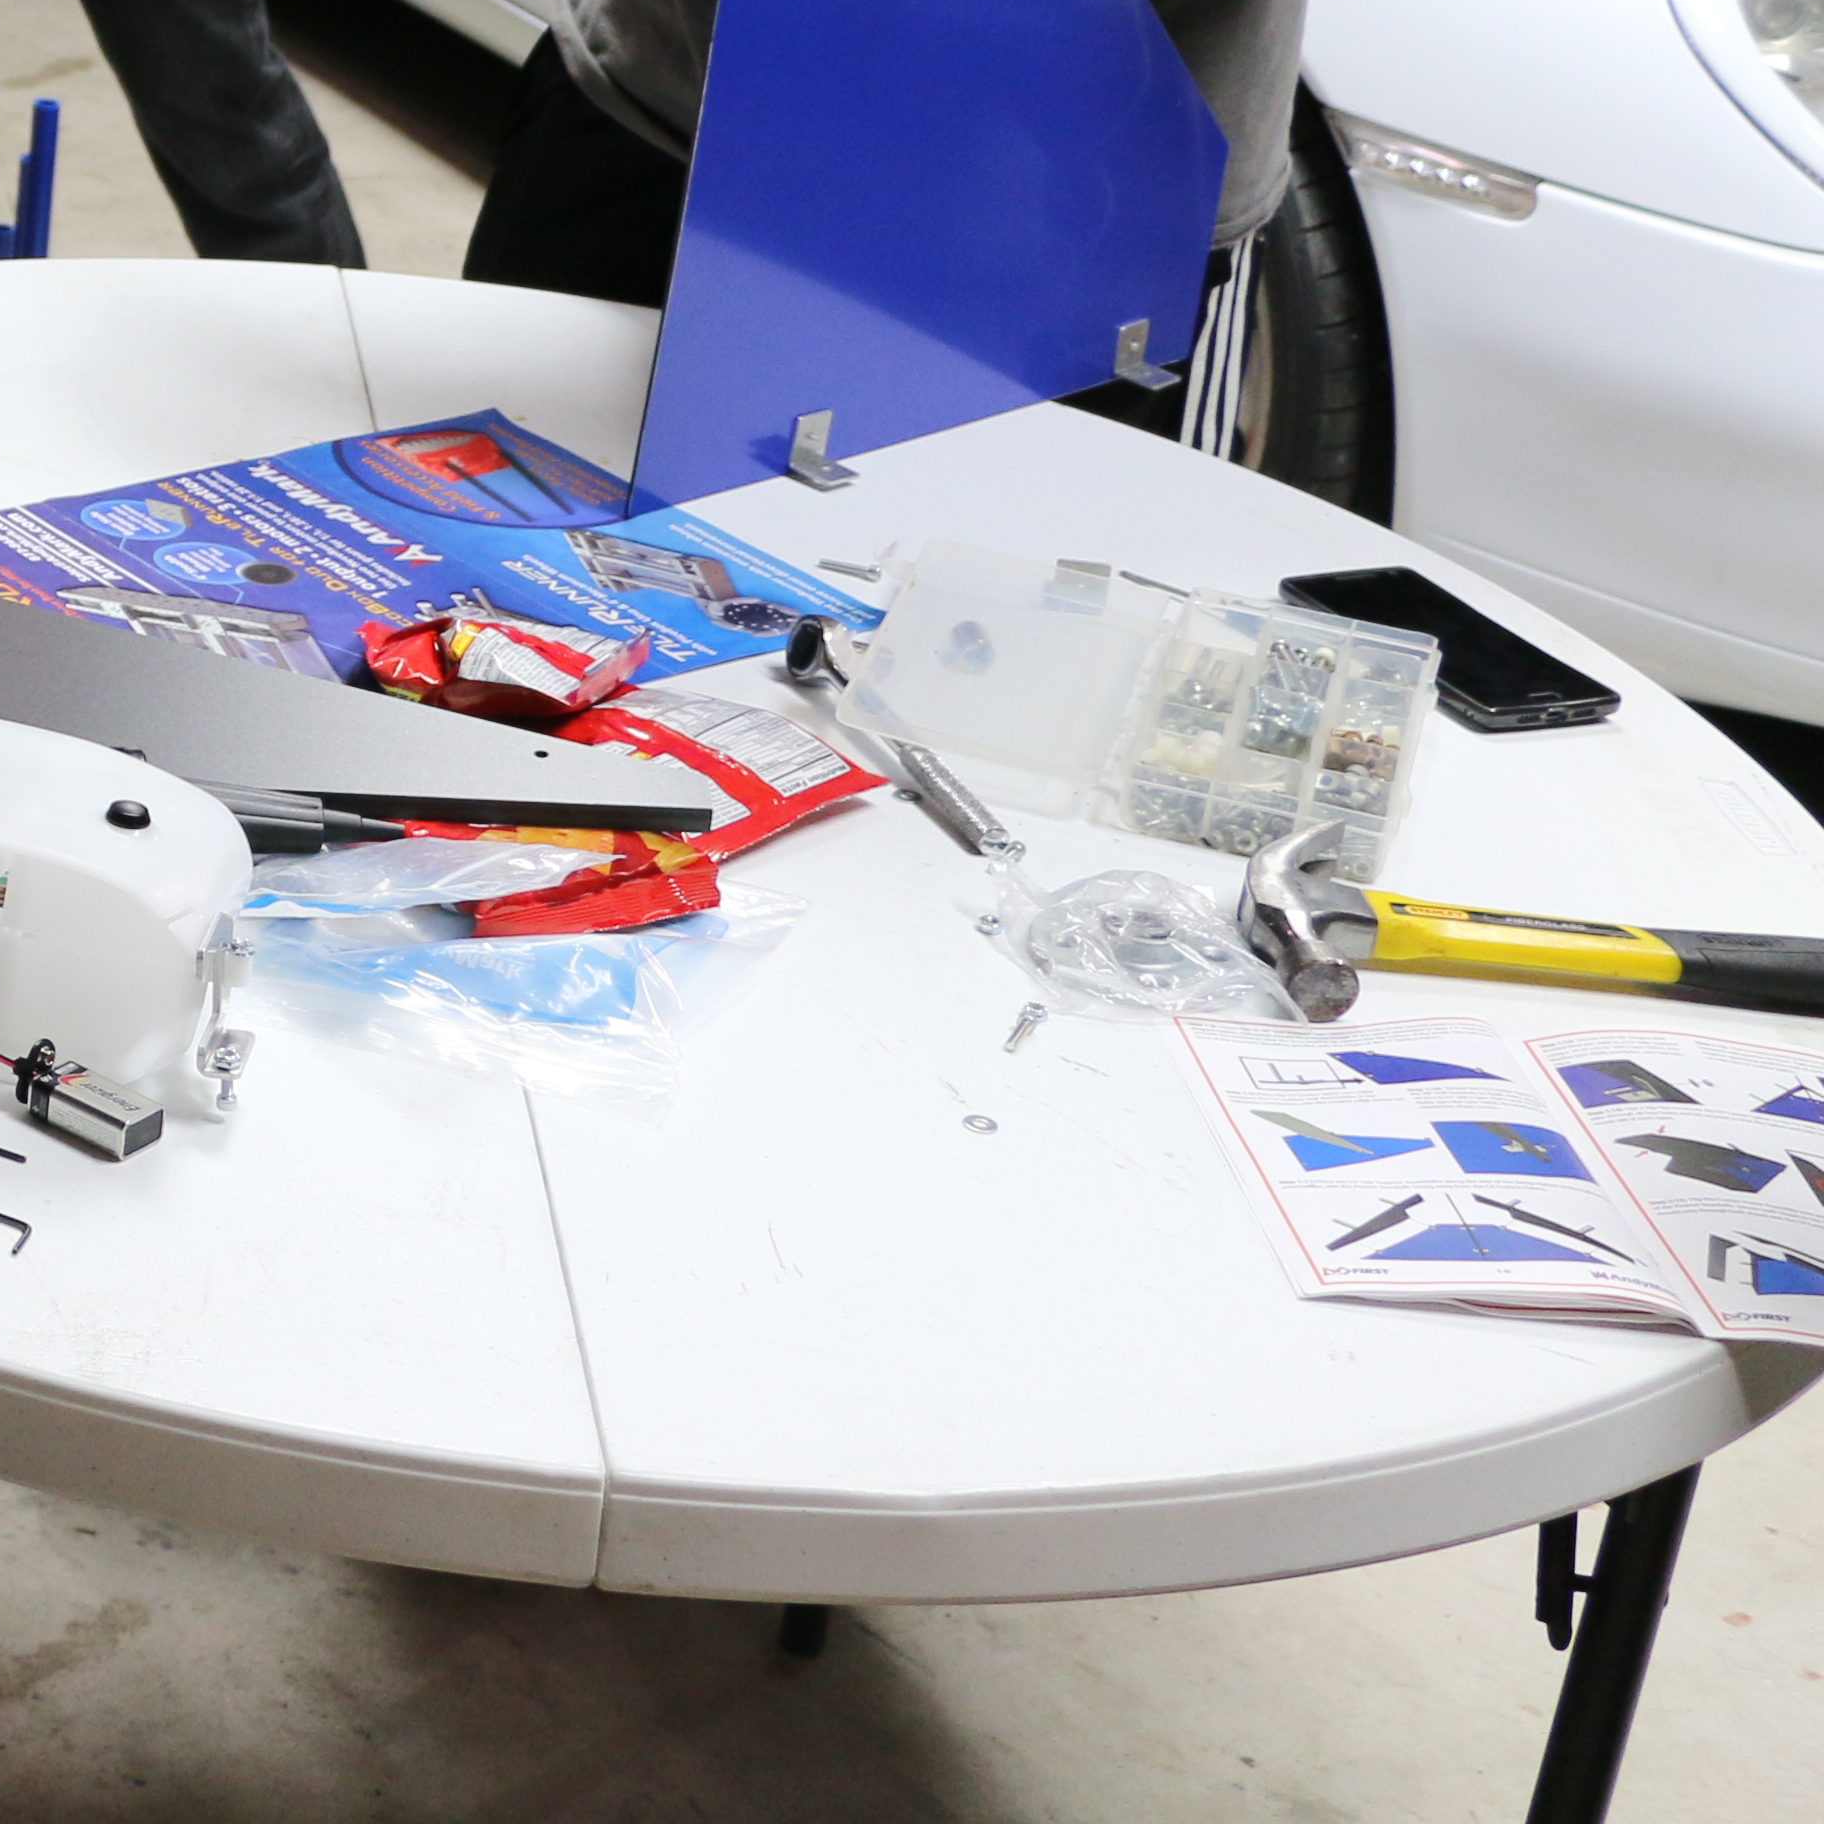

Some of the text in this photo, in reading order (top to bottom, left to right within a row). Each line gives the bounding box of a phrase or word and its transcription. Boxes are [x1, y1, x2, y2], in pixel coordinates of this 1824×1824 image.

[176, 476, 227, 504] ratios
[216, 502, 237, 513] 3
[248, 463, 406, 546] AndyMark
[240, 513, 301, 548] motors
[7, 512, 124, 580] AndyMark.com
[293, 544, 314, 556] 2
[315, 555, 377, 591] output
[1409, 906, 1464, 919] STANLEY
[80, 1081, 142, 1113] Energizer
[1351, 1267, 1390, 1275] FIRST
[1751, 1312, 1791, 1323] FIRST
